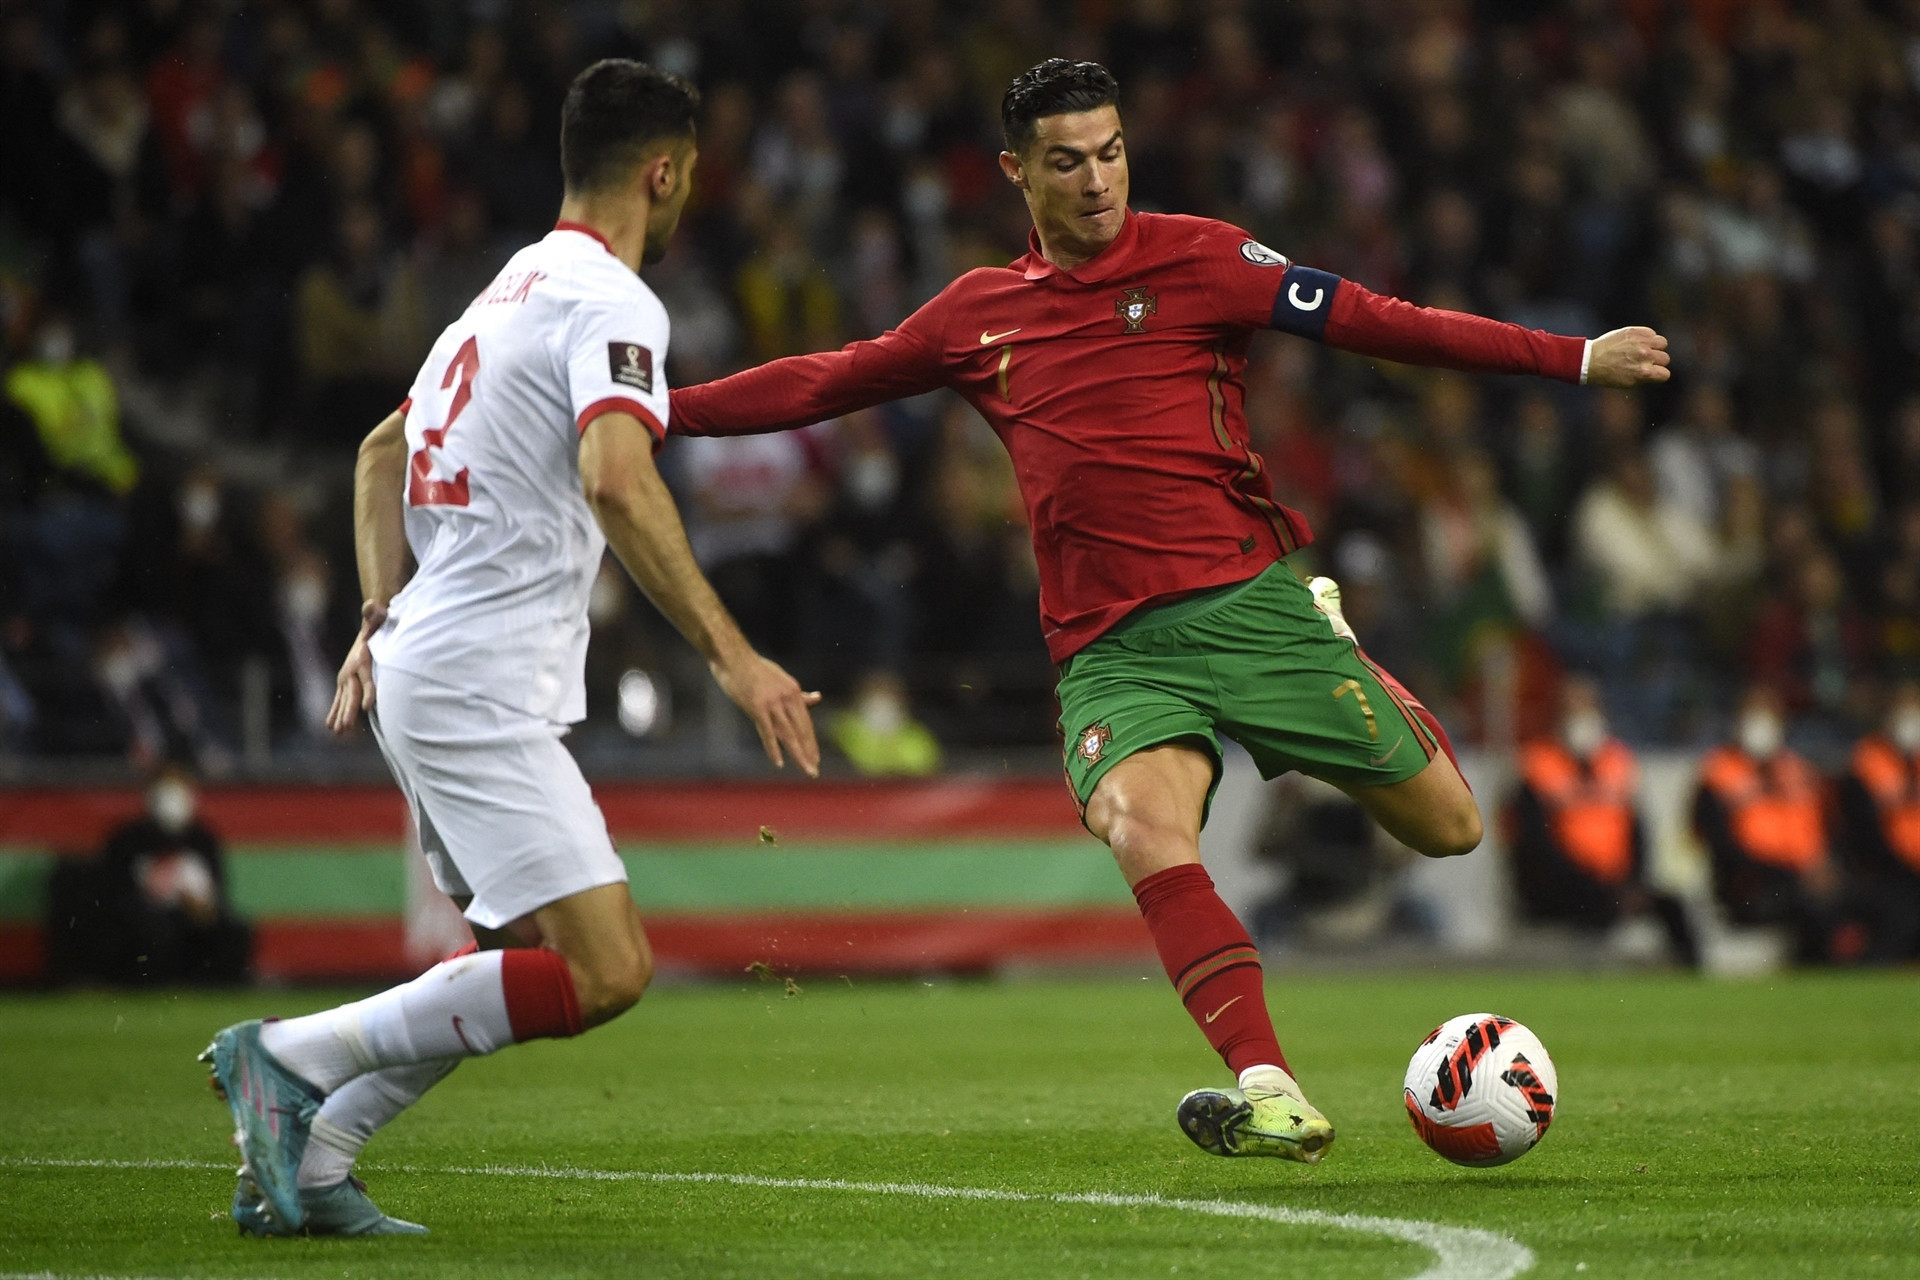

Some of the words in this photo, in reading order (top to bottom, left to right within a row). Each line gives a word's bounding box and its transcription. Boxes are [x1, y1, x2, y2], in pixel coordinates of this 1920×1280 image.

[1288, 282, 1324, 311] C
[409, 334, 480, 507] 2
[1332, 679, 1378, 741] 7
